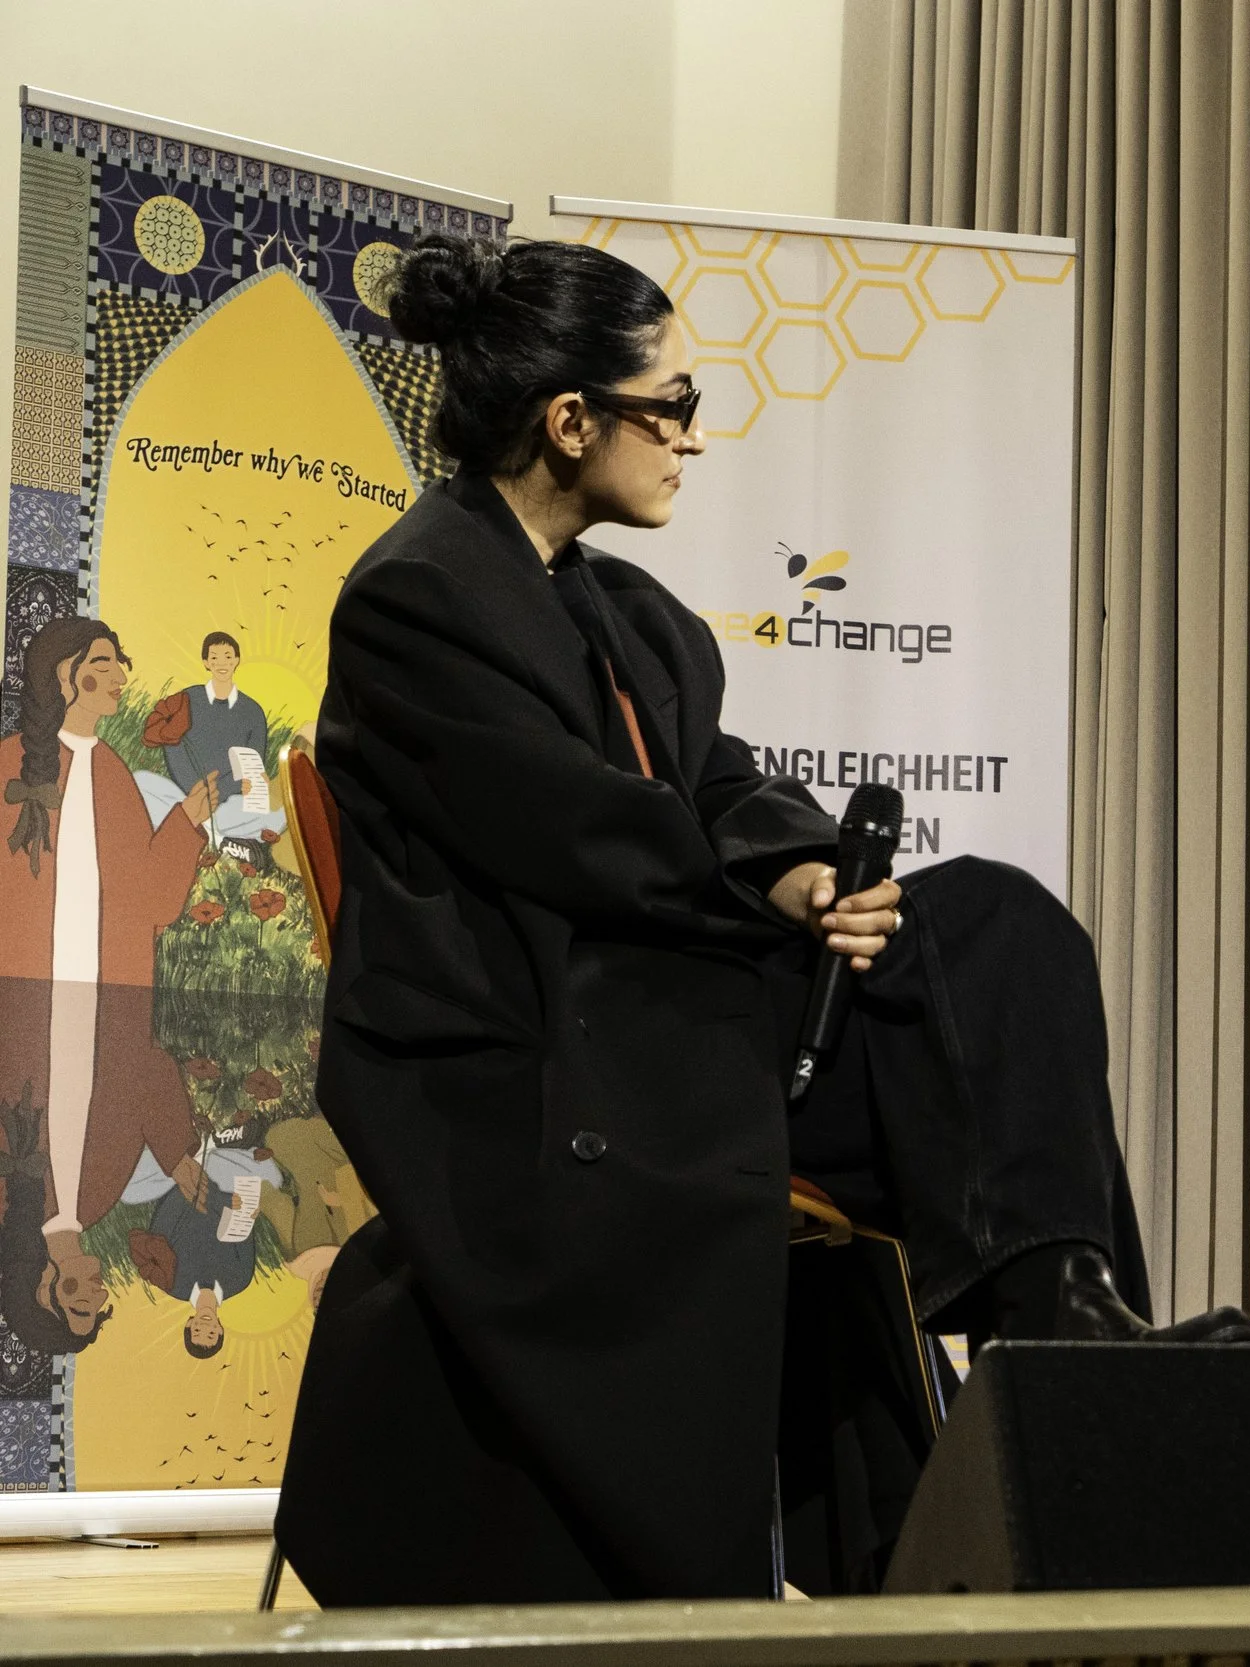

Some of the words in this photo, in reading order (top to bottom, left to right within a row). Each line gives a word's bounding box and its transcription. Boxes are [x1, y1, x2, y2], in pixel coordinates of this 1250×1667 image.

[126, 437, 244, 473] Remember
[251, 447, 302, 480] why
[298, 459, 325, 483] we
[330, 461, 407, 512] Started
[799, 1058, 814, 1077] 2
